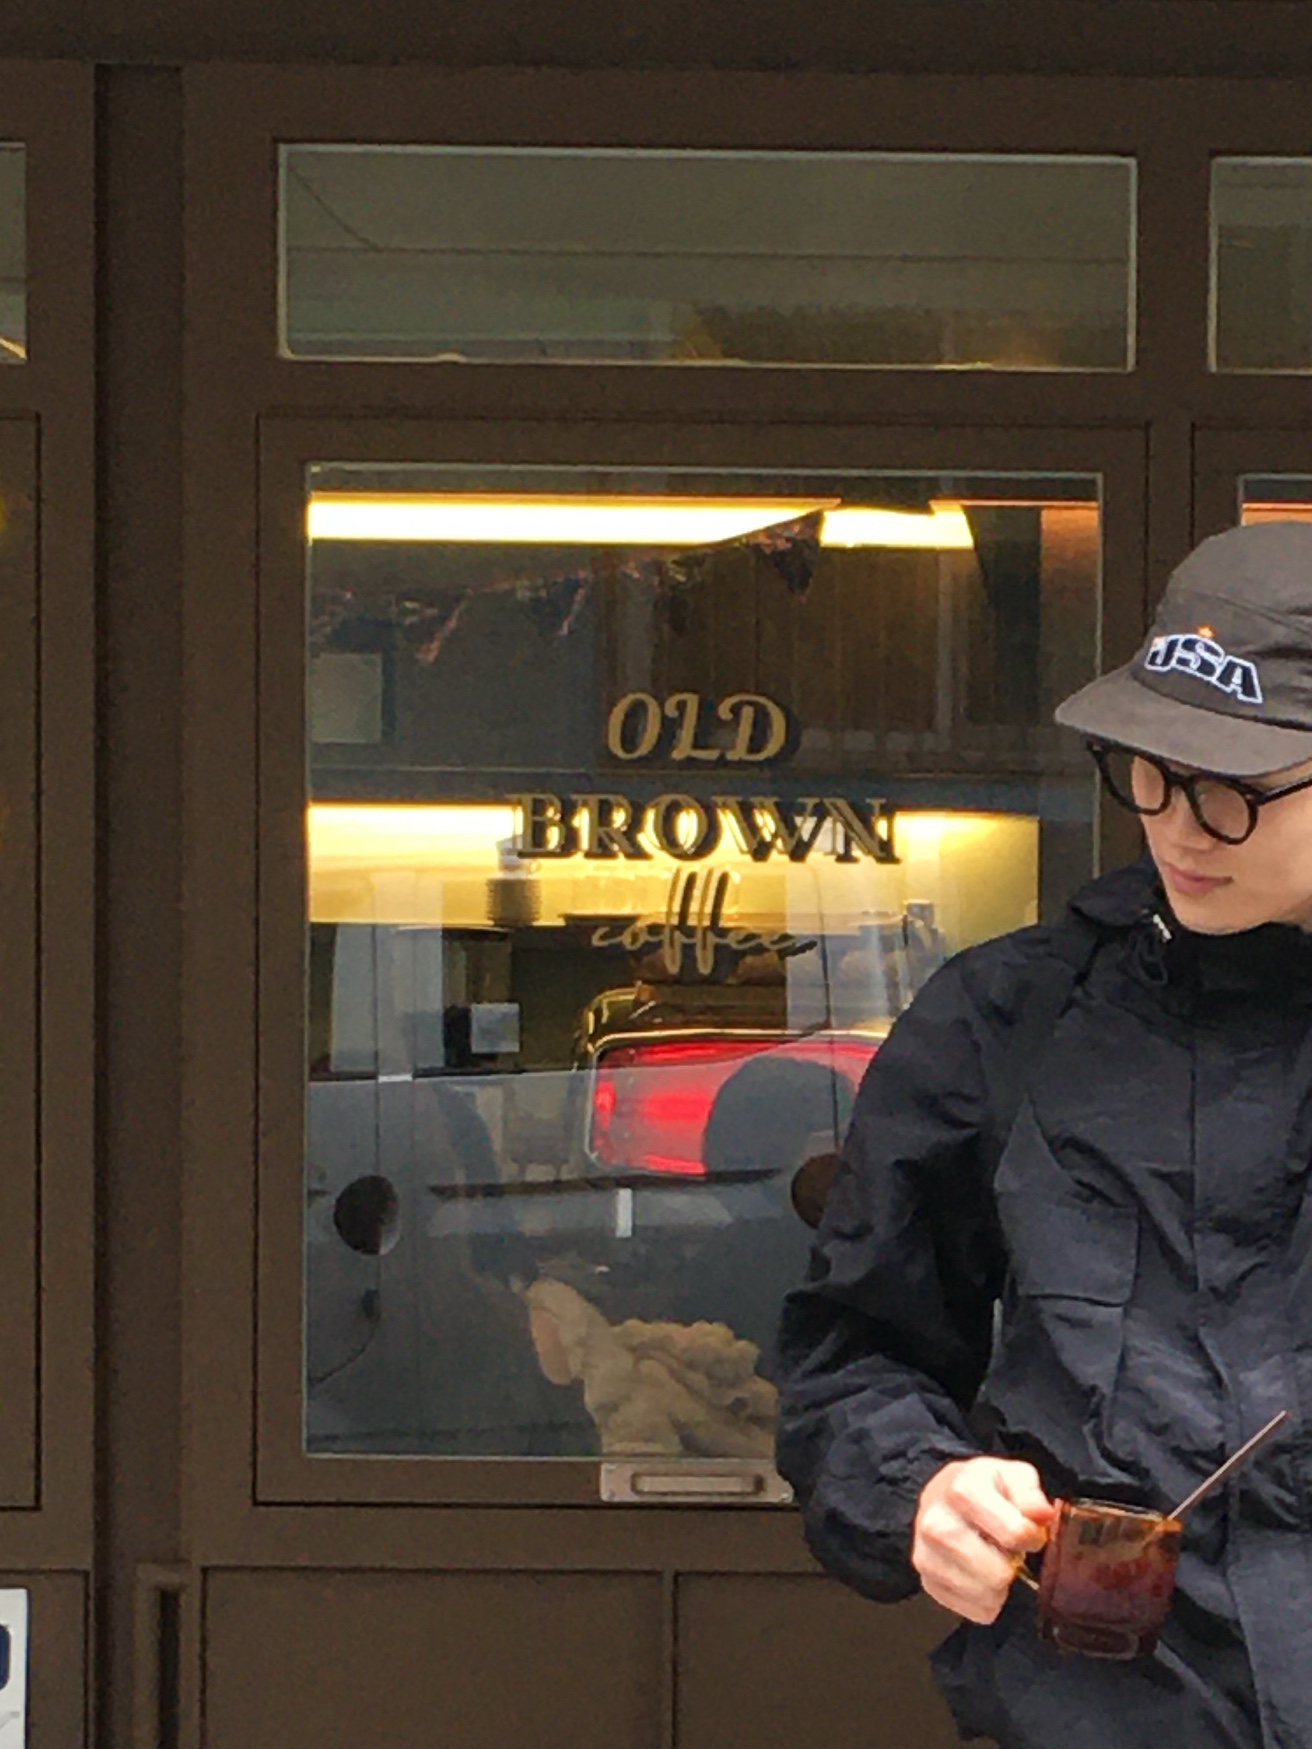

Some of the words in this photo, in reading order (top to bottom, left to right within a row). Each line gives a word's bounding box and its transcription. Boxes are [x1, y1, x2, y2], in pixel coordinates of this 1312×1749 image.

[606, 691, 796, 762] OLD
[504, 790, 902, 864] BROWN
[591, 866, 816, 975] coffee
